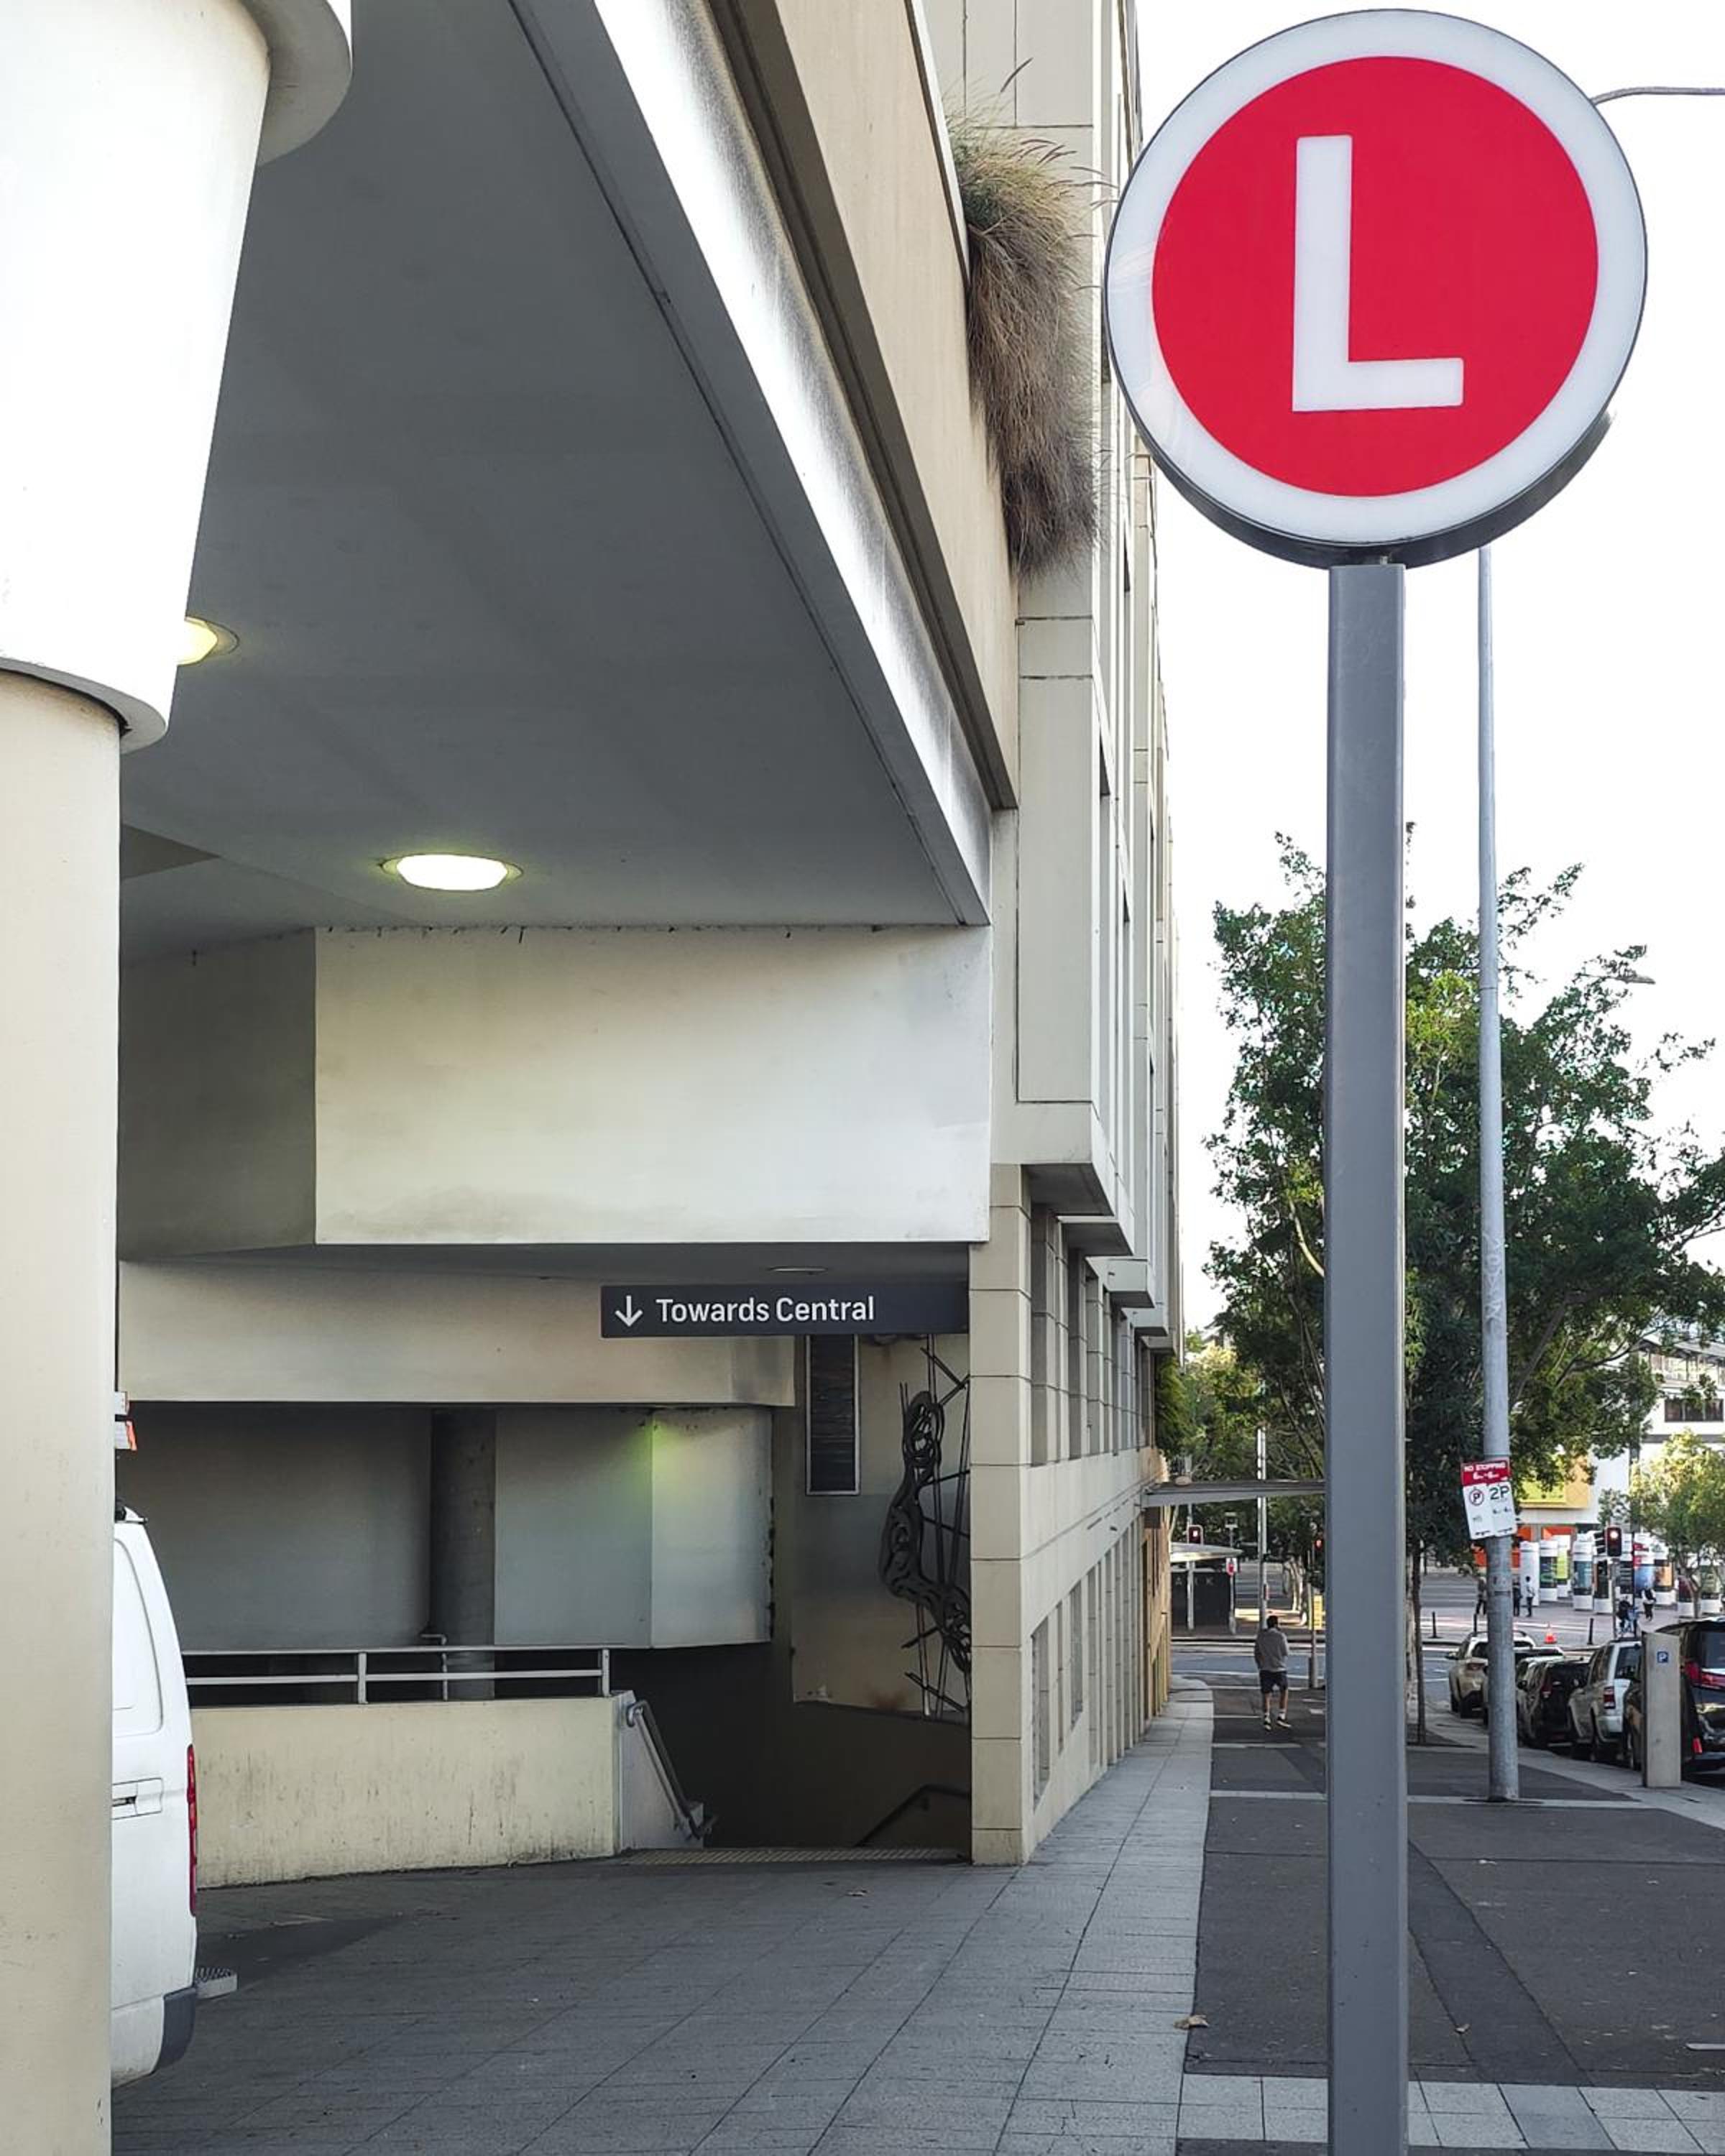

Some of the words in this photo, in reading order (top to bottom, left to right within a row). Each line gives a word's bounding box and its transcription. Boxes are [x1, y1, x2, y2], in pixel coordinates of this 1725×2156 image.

[1292, 134, 1464, 412] L
[656, 1297, 770, 1323] Towards
[776, 1296, 875, 1322] Central
[1489, 1485, 1510, 1500] 2P
